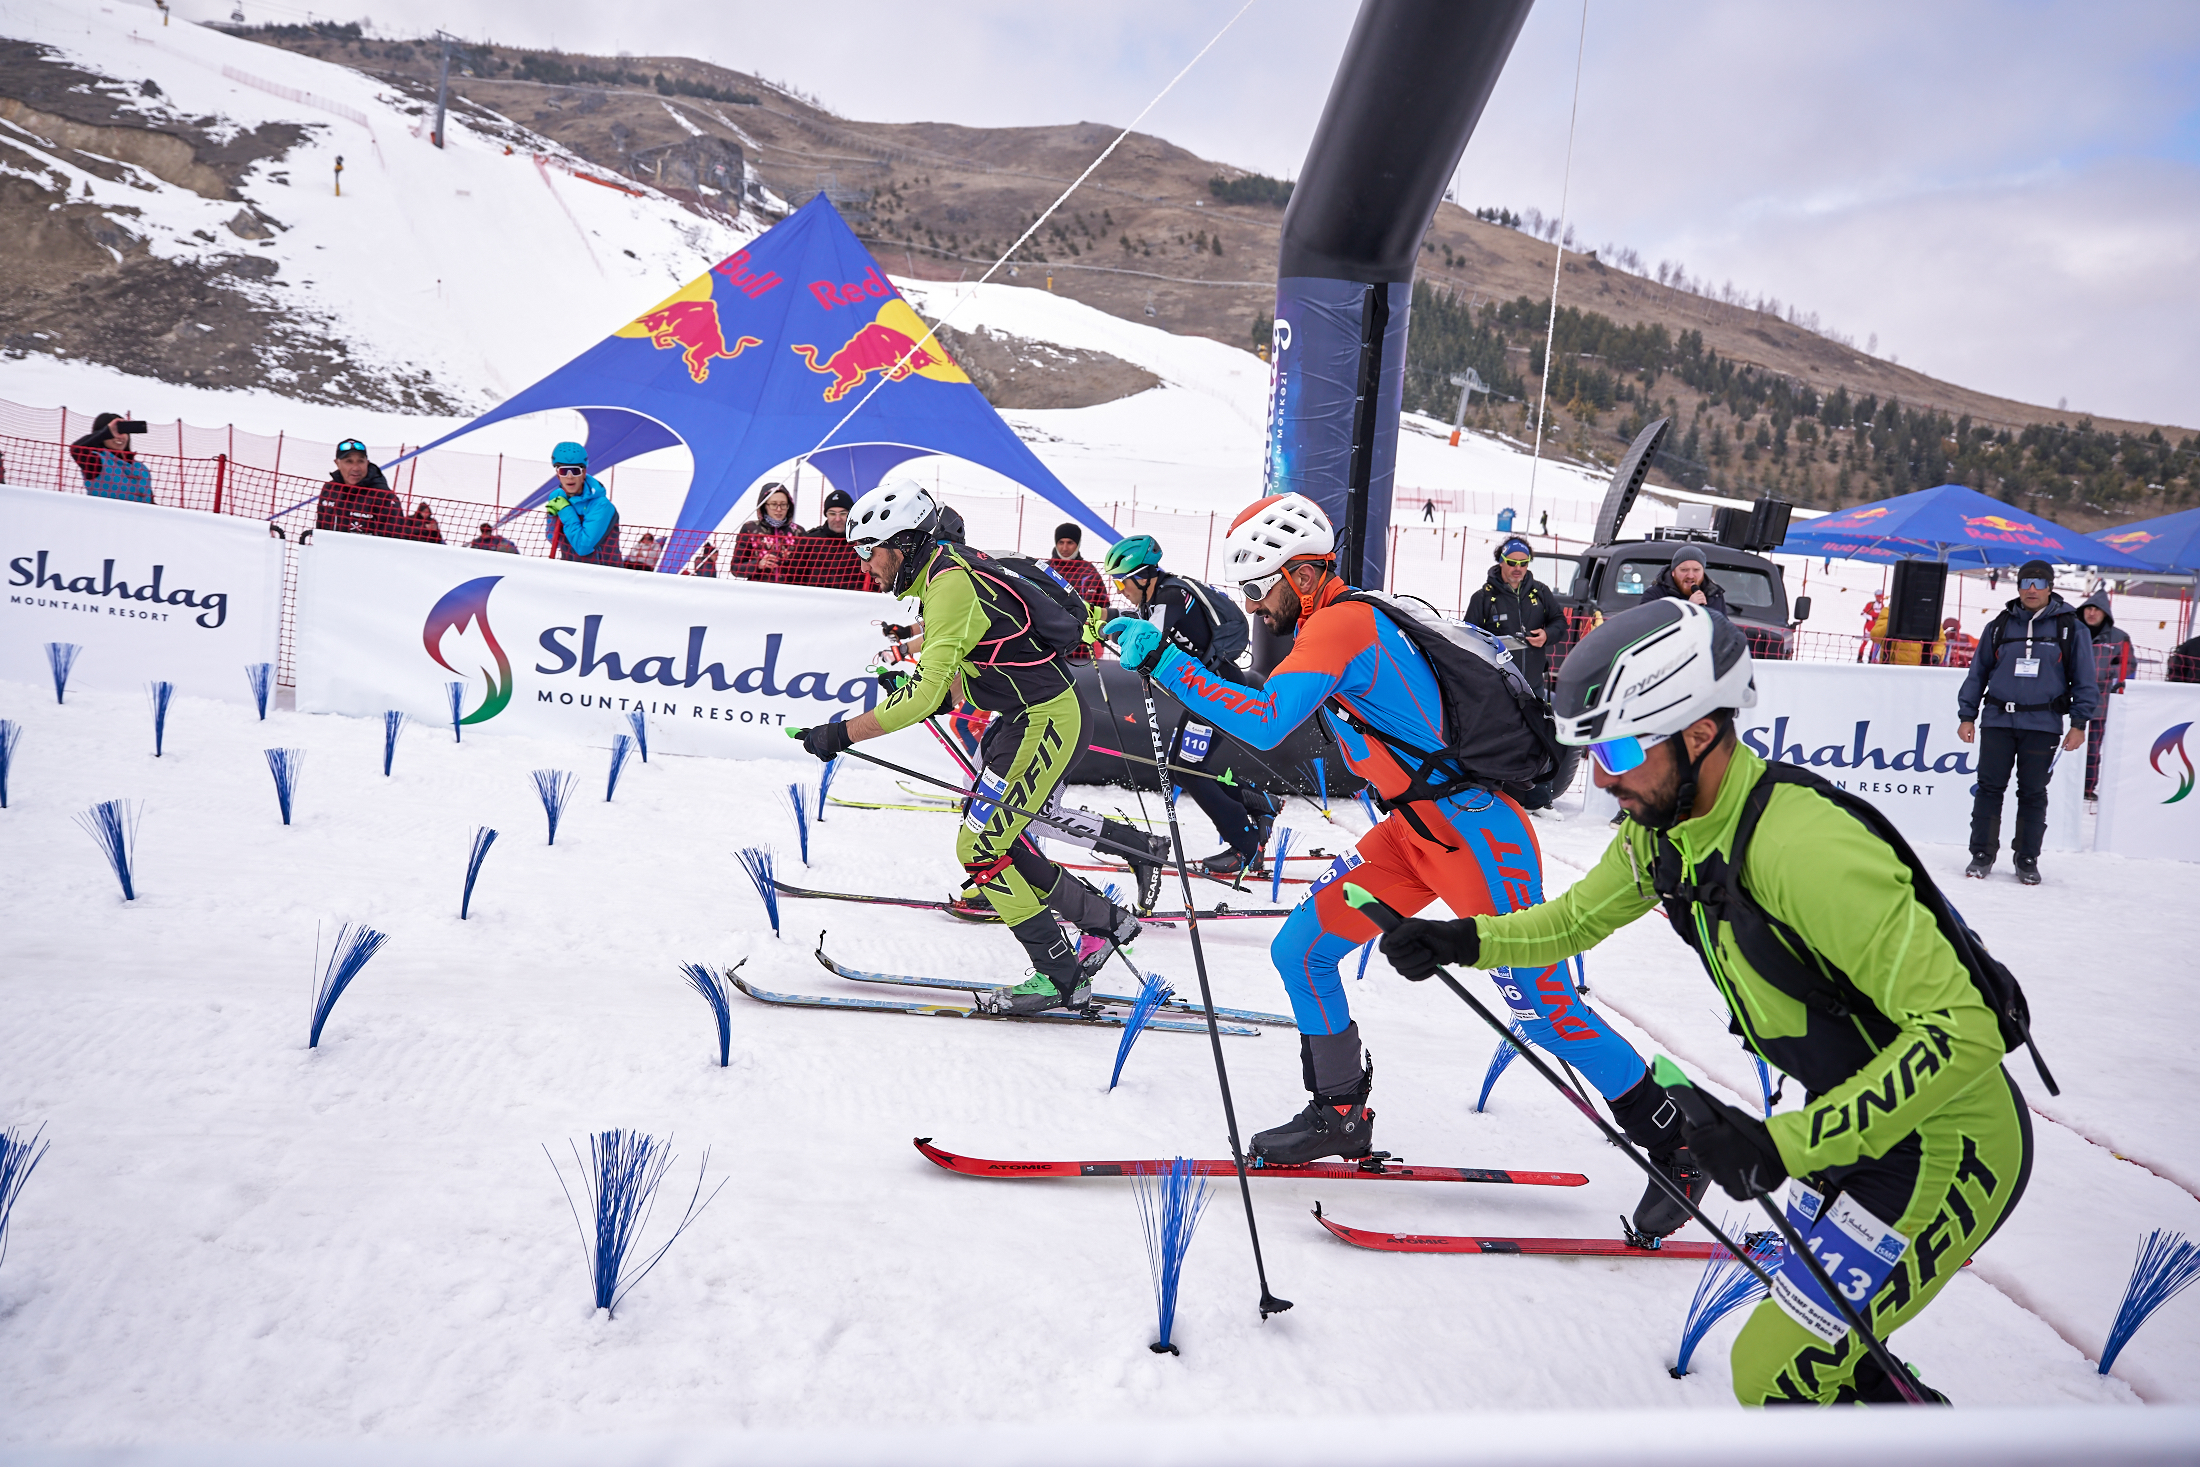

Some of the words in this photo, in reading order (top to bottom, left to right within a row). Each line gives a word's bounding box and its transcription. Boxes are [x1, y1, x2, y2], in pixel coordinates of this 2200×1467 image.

[714, 249, 784, 299] Bull
[807, 266, 891, 311] Red
[9, 550, 228, 629] Shahdag
[11, 595, 100, 614] MOUNTAIN
[108, 606, 170, 623] RESORT
[534, 614, 881, 724] Shahdag
[537, 690, 677, 717] MOUNTAIN
[692, 705, 787, 727] RESORT
[1184, 736, 1208, 751] 110
[1859, 781, 1935, 796] RESORT
[987, 1163, 1053, 1171] ATOMIC
[1386, 1238, 1450, 1246] ATOMIC
[1876, 1245, 1897, 1263] ISMF
[1791, 1291, 1809, 1309] ISMF
[1808, 1307, 1832, 1327] Series
[1832, 1324, 1846, 1335] Ski
[1814, 1322, 1834, 1338] Race
